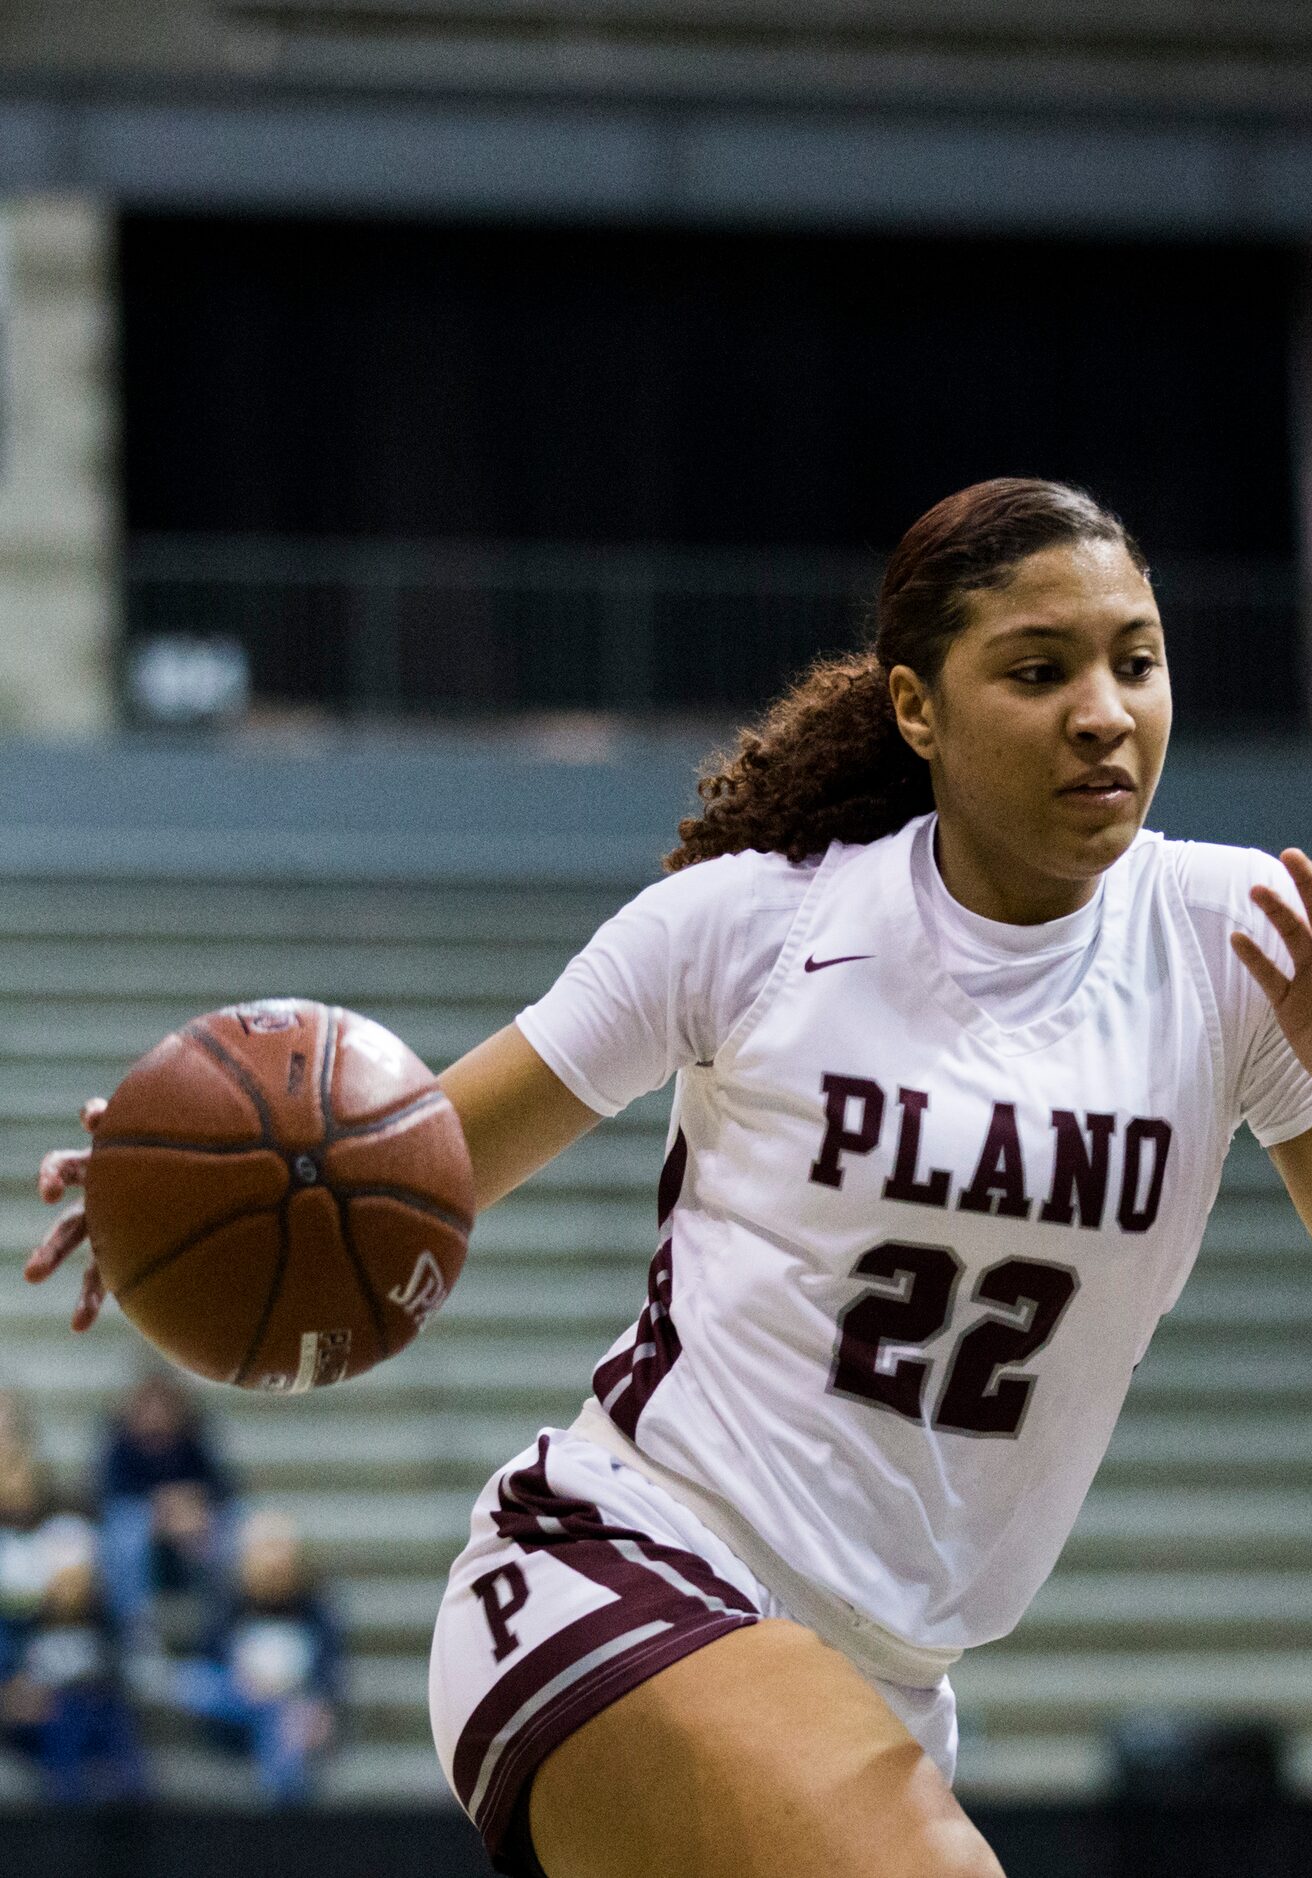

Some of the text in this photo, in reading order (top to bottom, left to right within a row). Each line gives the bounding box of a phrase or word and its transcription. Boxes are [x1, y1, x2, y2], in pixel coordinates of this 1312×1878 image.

[808, 1071, 1172, 1235] PLANO
[825, 1238, 1081, 1440] 22
[471, 1560, 531, 1665] P
